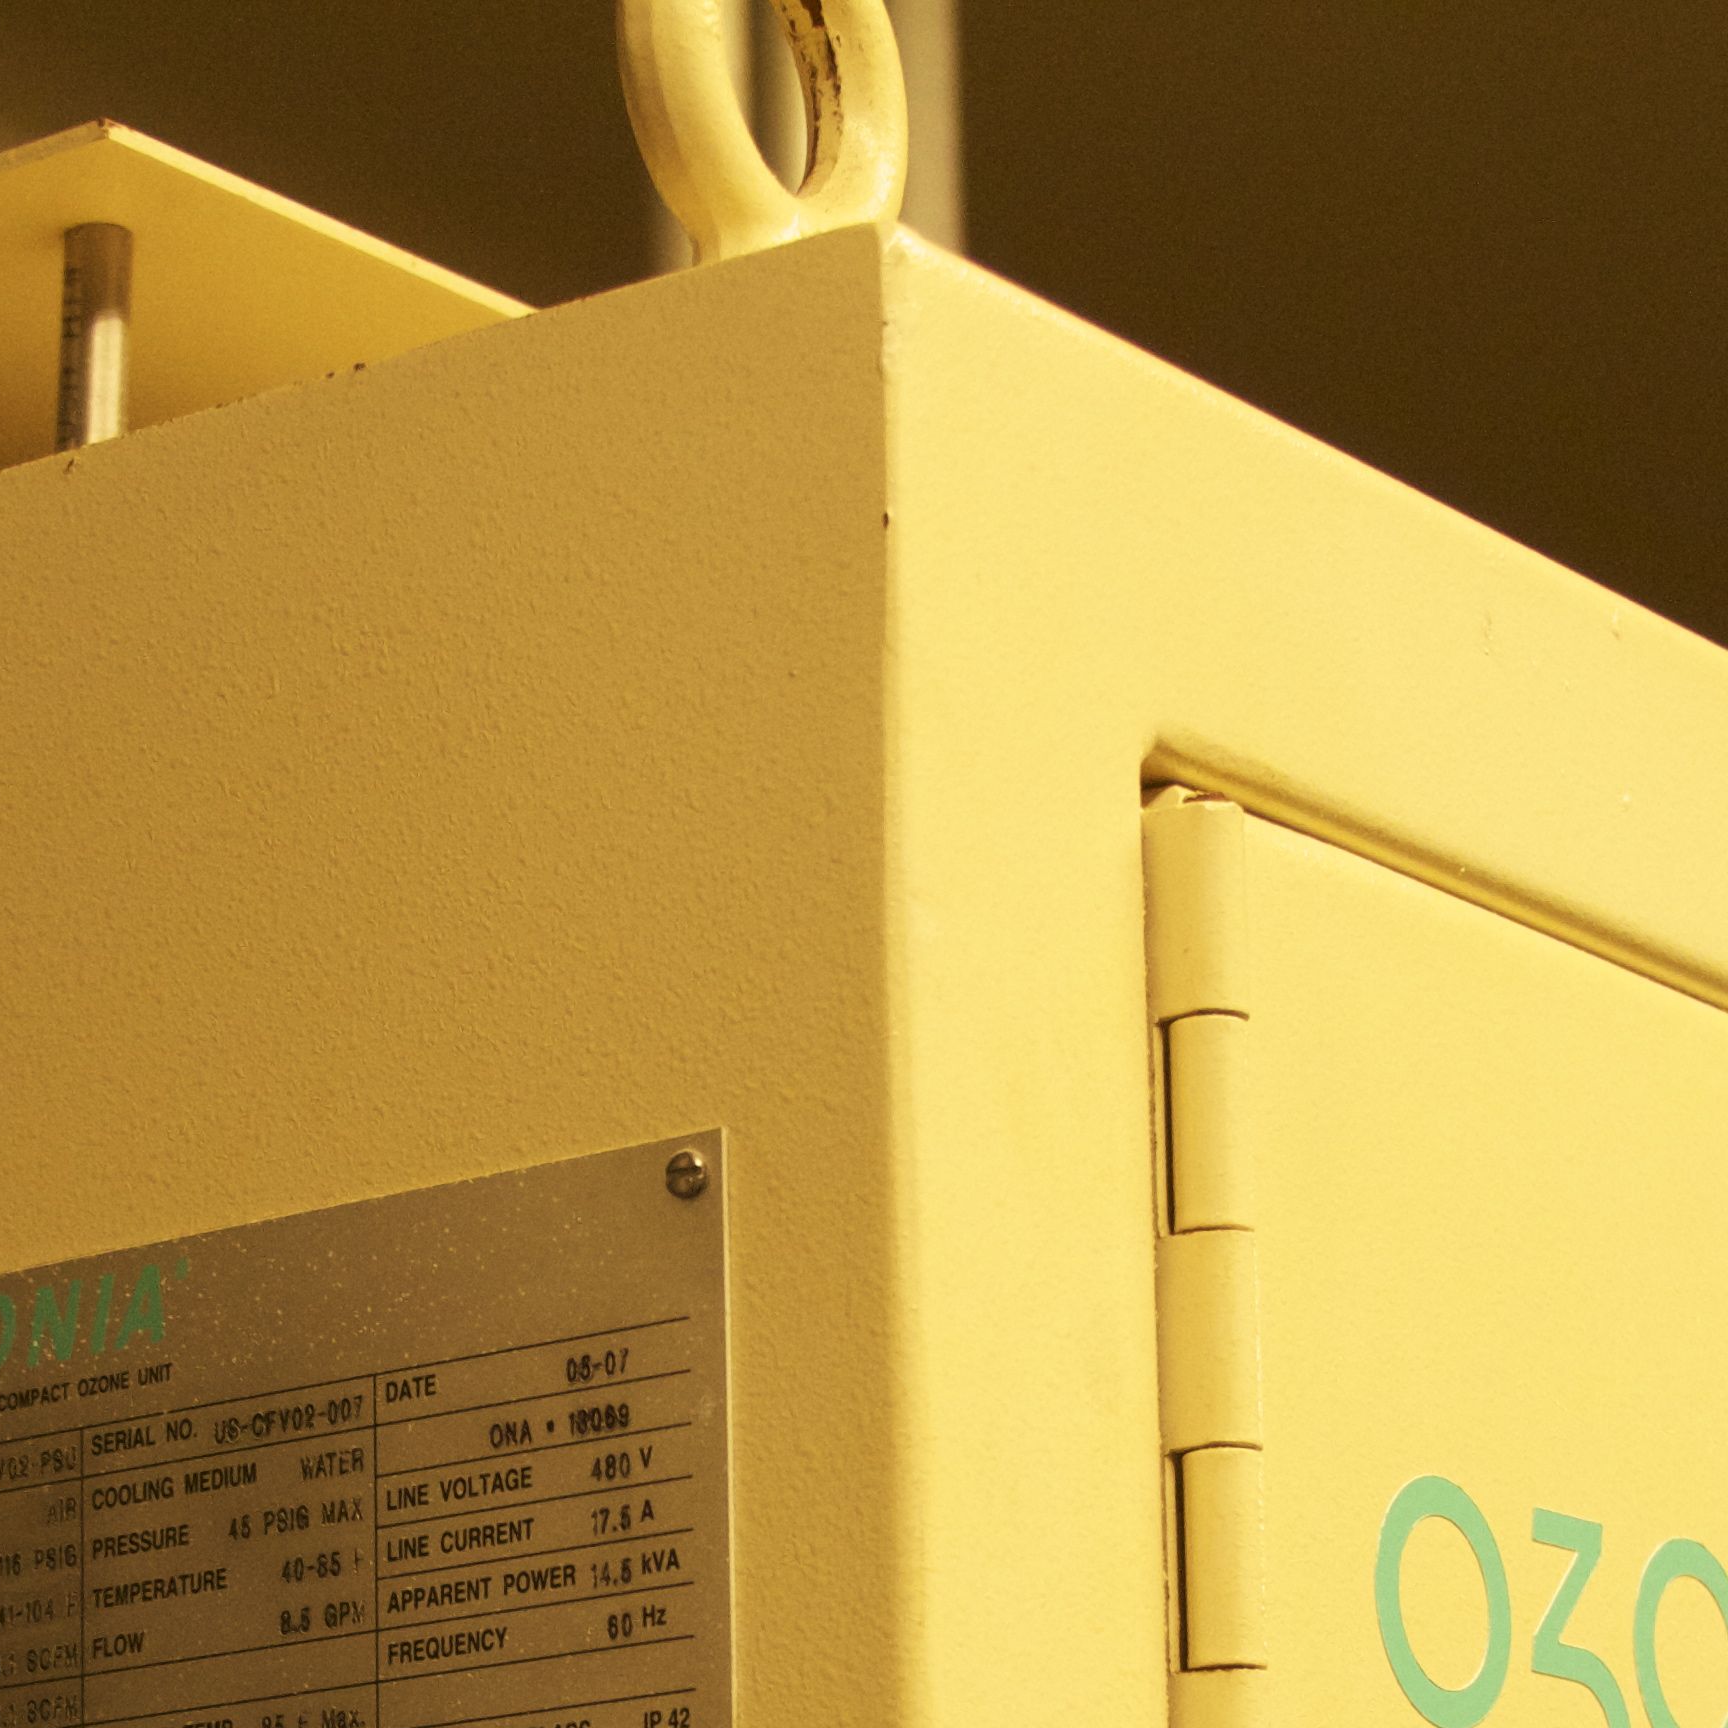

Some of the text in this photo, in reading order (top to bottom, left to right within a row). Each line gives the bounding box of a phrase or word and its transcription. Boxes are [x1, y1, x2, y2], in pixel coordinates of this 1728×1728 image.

[76, 1370, 130, 1398] OZONE
[137, 1362, 173, 1387] UNIT
[385, 1374, 437, 1404] DATE
[91, 1426, 156, 1457] SERIAL
[166, 1418, 198, 1441] NO.
[488, 1419, 533, 1449] ONA
[91, 1447, 365, 1511] COOLING MEDIUM WATER
[386, 1445, 653, 1511] LINE VOLTAGE 480 V
[33, 1543, 78, 1571] PSIG
[92, 1524, 190, 1560] PRESSURE
[263, 1504, 310, 1535] PSIG
[321, 1497, 364, 1526] MAX
[386, 1536, 430, 1562] LINE
[440, 1517, 535, 1553] CURRENT
[639, 1498, 655, 1523] A
[92, 1567, 228, 1609] TEMPERATURE
[387, 1575, 492, 1614] APPARENT
[502, 1563, 576, 1595] POWER
[640, 1548, 681, 1576] kVA
[92, 1631, 145, 1660] FLOW
[323, 1600, 365, 1629] GPM
[386, 1627, 508, 1666] FREQUENCY
[642, 1603, 668, 1628] Hz
